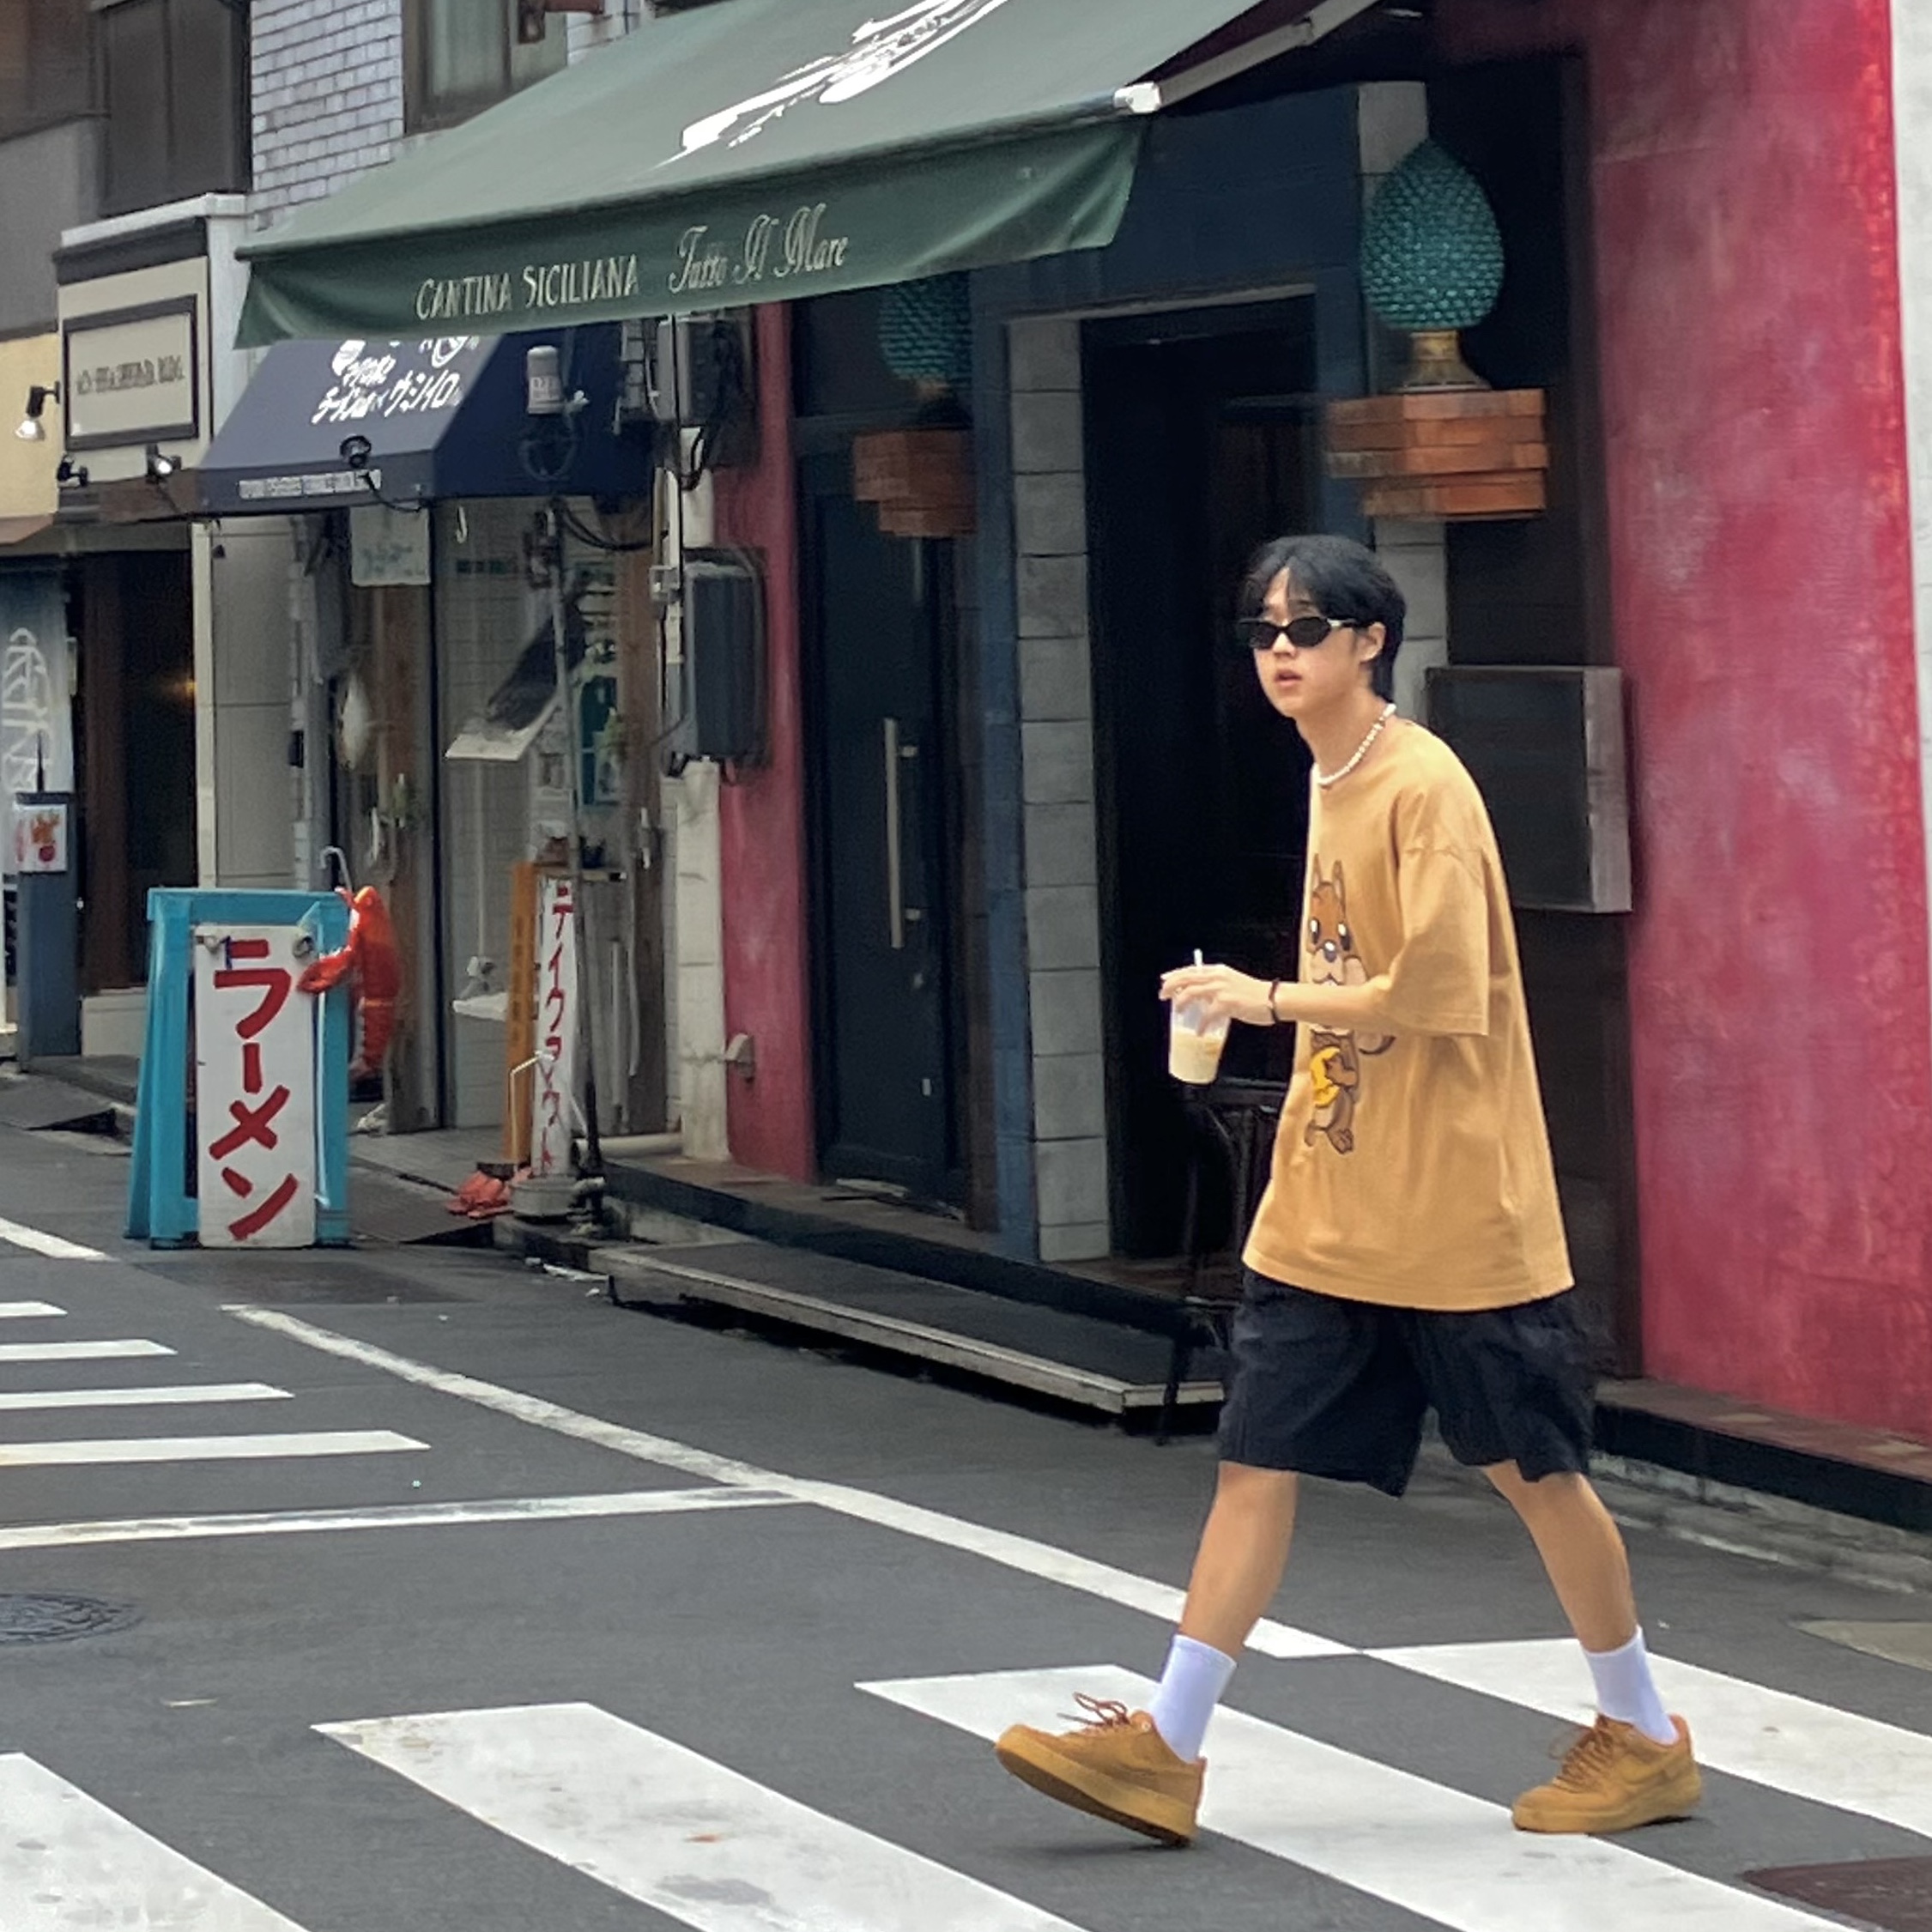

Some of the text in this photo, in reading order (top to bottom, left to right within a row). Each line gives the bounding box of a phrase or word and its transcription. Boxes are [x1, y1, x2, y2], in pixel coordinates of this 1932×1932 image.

[416, 272, 512, 321] CANTINA
[523, 253, 639, 309] SICILIANA
[773, 203, 849, 277] Mare
[209, 939, 298, 1240] ラーメン
